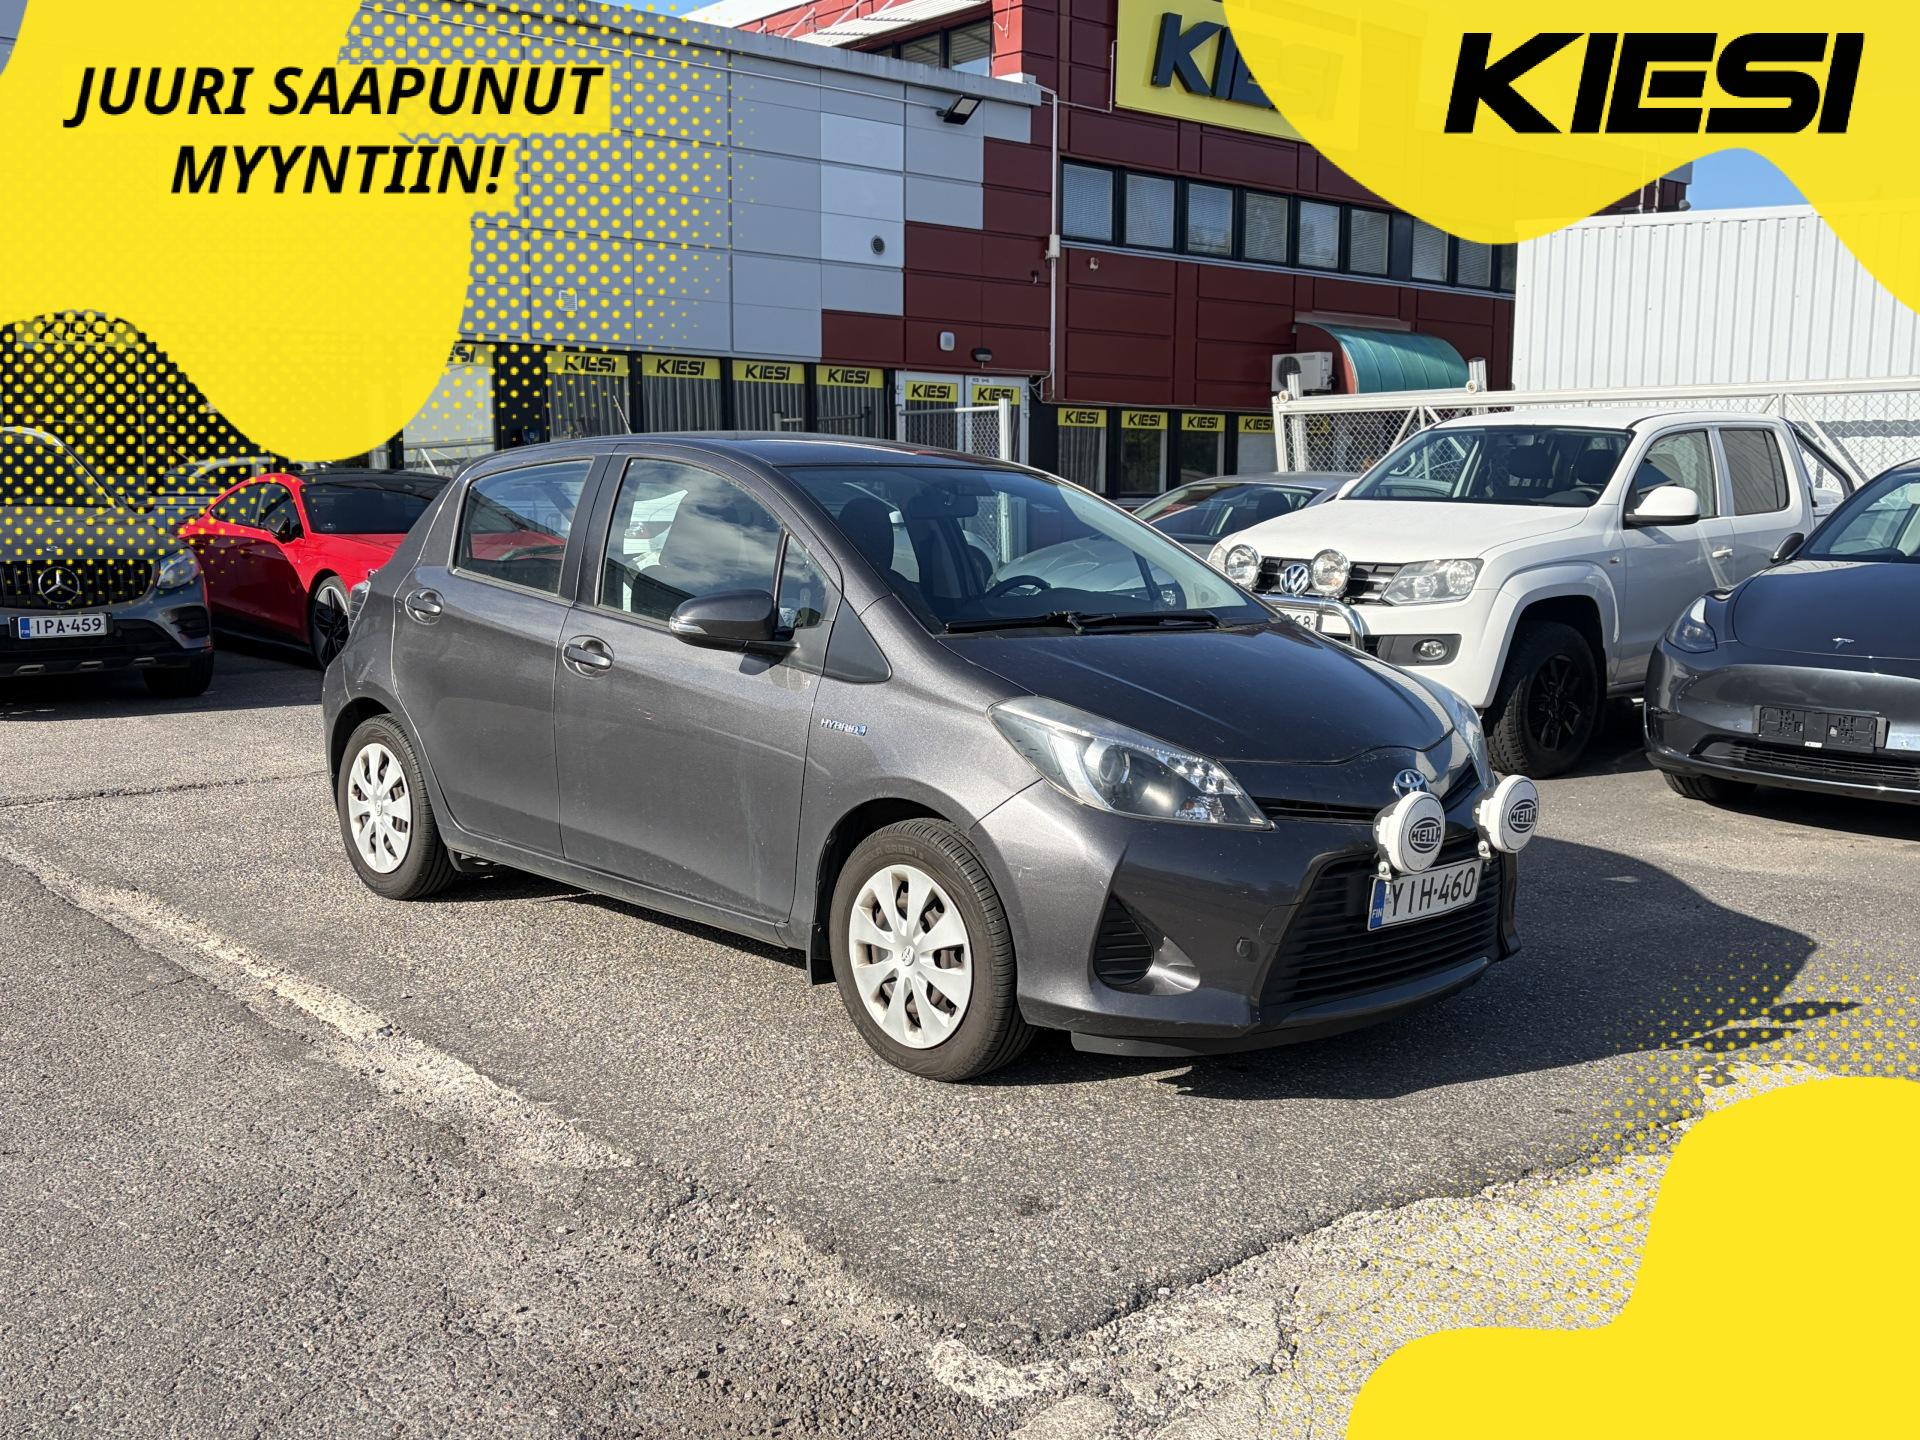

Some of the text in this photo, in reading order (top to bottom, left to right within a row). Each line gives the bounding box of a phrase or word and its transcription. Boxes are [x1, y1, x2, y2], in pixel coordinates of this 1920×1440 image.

[563, 354, 617, 373] KIESI
[656, 358, 705, 376] KIESI
[745, 364, 791, 381] KIESI
[827, 368, 870, 385] KIESI
[911, 383, 952, 400] KIESI
[977, 387, 1014, 402] KIESI
[1064, 410, 1100, 426] KIESI
[1127, 414, 1161, 428] KIESI
[1187, 416, 1219, 430] KIESI
[1244, 418, 1274, 431] KIESI
[1510, 808, 1537, 825] HELLA
[1411, 827, 1442, 844] HELLA
[1392, 867, 1476, 917] YIH-460
